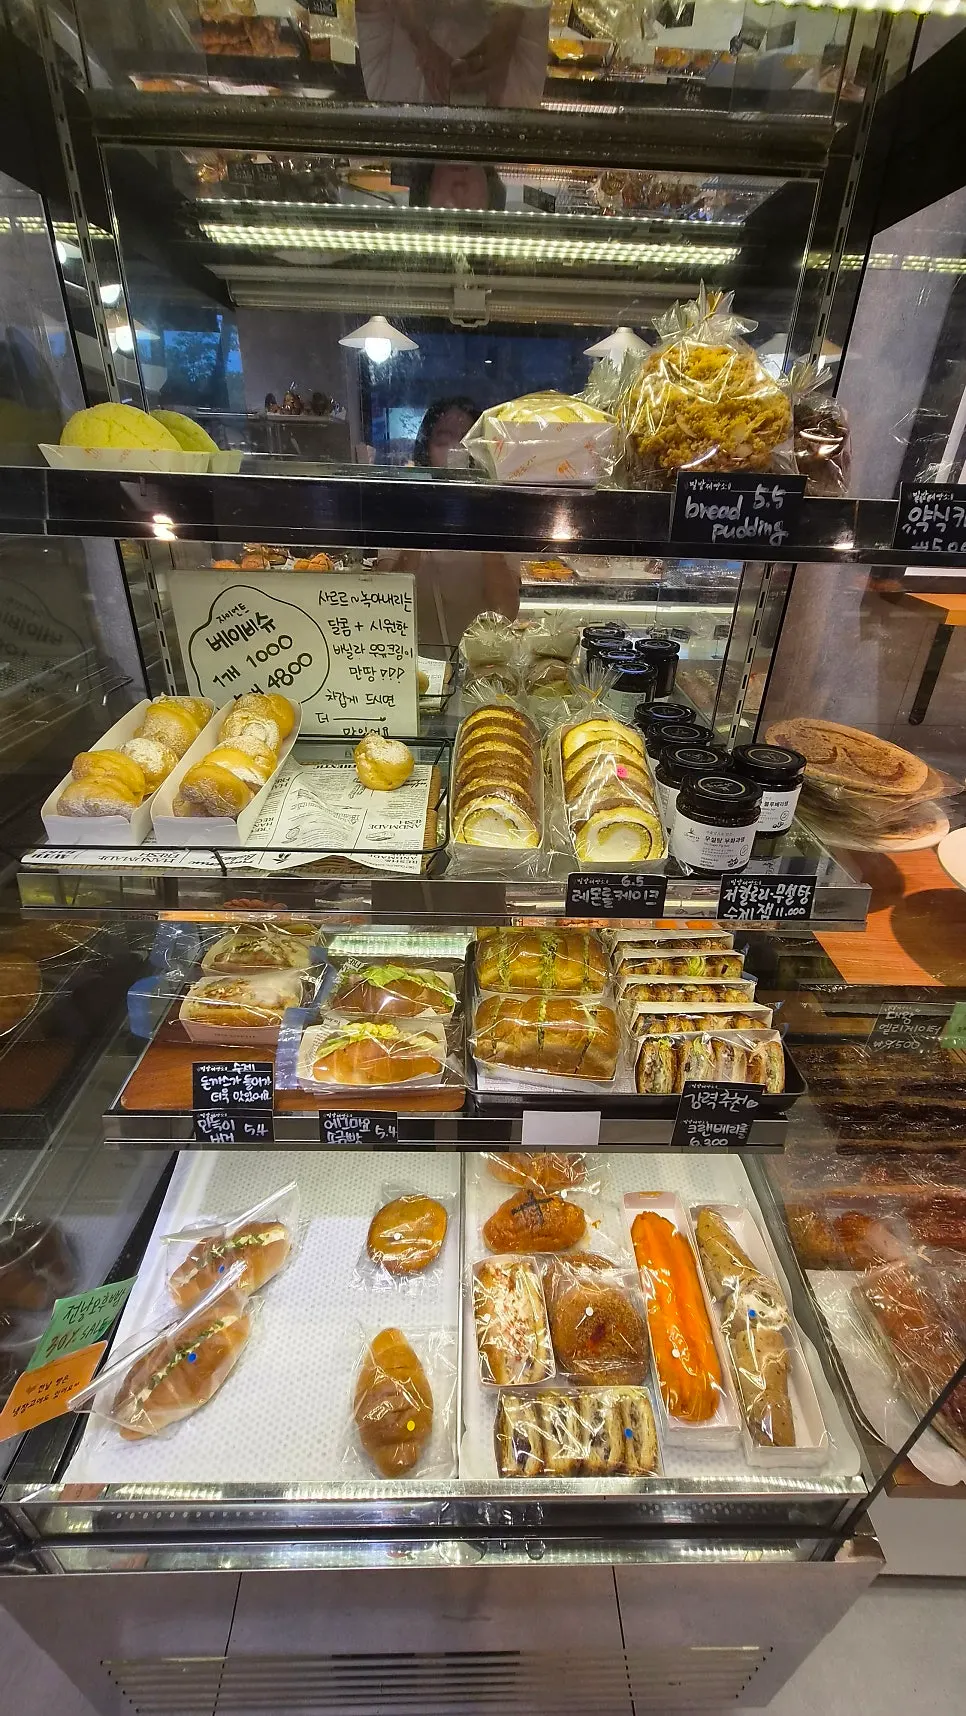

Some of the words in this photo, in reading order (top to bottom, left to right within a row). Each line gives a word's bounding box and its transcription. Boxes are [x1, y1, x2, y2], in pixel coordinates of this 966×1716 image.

[753, 483, 786, 510] 5.5
[684, 494, 743, 520] bread
[712, 516, 789, 546] pudding
[215, 602, 249, 624] 자이언트
[205, 611, 276, 652] 베이비슈
[328, 617, 351, 636] 달콤
[370, 618, 408, 636] 시원한
[212, 664, 241, 687] 1개
[245, 634, 293, 668] 1000
[333, 643, 365, 660] 바닐라
[369, 643, 413, 661] 우유크림이
[267, 652, 313, 689] 4800
[349, 665, 377, 682] 만땅
[325, 689, 358, 708] 차갑게
[365, 693, 395, 707] 드시면
[315, 712, 330, 723] 더
[621, 875, 645, 887] 6.5
[571, 887, 660, 909] 레몬롤케이크
[885, 1011, 915, 1025] 대왕
[200, 1075, 242, 1091] 돈까스가
[210, 1088, 230, 1104] 더욱
[244, 1123, 269, 1136] 5.4
[375, 1124, 398, 1139] 5.4
[687, 1123, 750, 1140] 크랜베리롤
